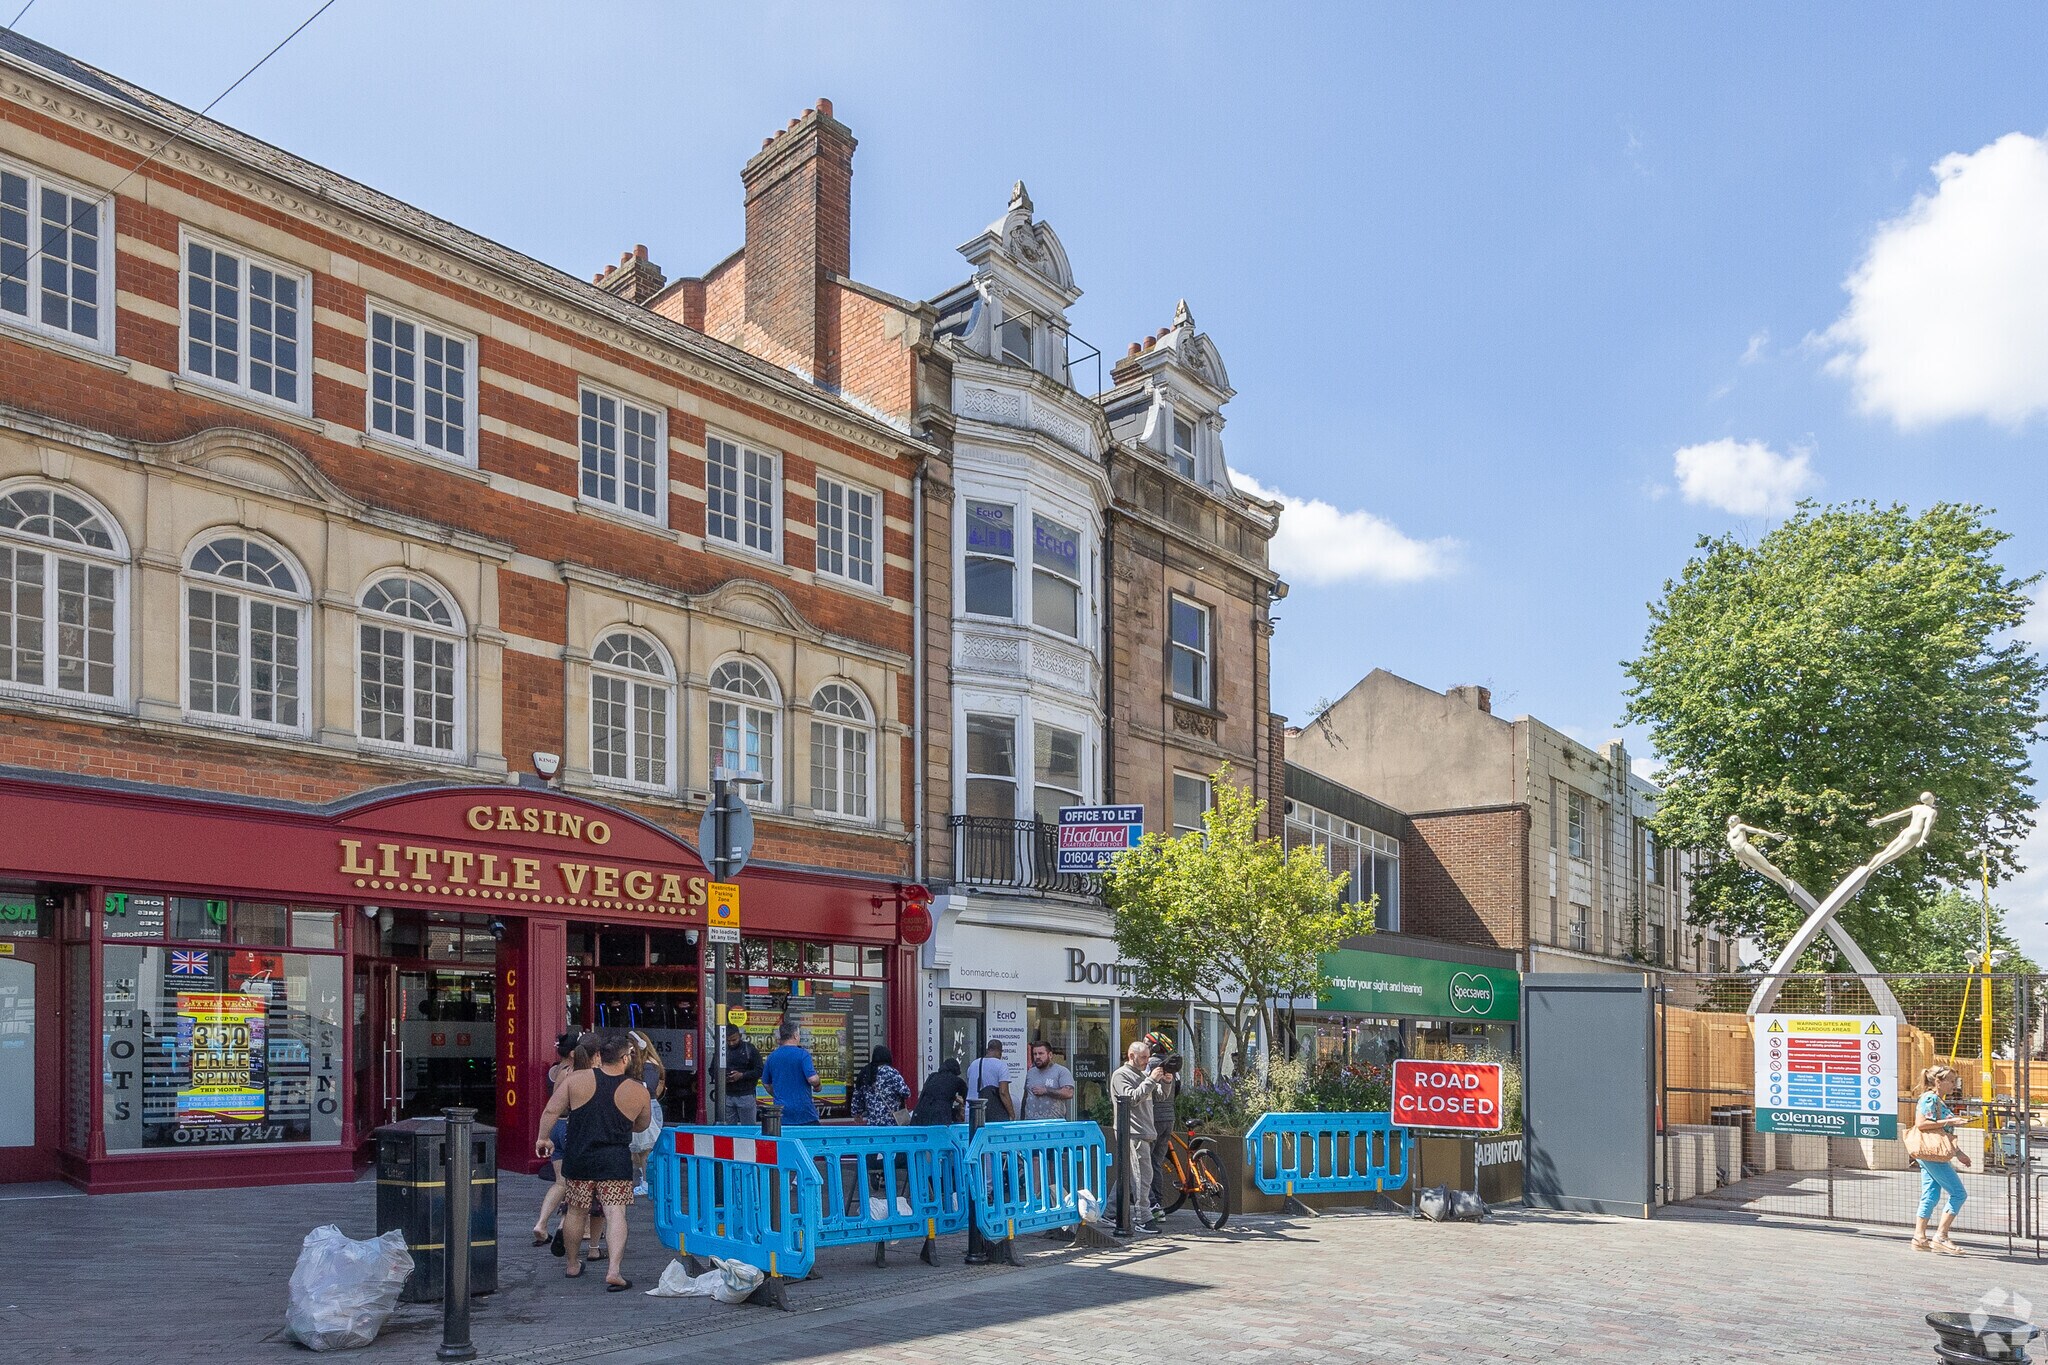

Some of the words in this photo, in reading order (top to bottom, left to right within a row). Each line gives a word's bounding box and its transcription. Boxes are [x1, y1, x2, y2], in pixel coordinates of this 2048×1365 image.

[1065, 811, 1099, 822] OFFICE
[1102, 811, 1115, 820] TO
[1118, 810, 1136, 820] LET
[466, 805, 611, 845] CASINO
[1063, 827, 1126, 843] Hadland
[1064, 852, 1094, 863] 01604
[339, 839, 541, 891] LITTLE
[559, 863, 707, 906] VEGAS
[960, 966, 1019, 979] bonmarche.co.uk
[1347, 976, 1357, 988] for
[1357, 979, 1372, 991] your
[1373, 980, 1388, 992] sight
[1389, 981, 1400, 992] and
[1401, 982, 1423, 997] hearing
[1454, 984, 1490, 1000] Specsavers
[184, 999, 222, 1007] LITTLE
[226, 999, 258, 1007] VEGAS
[196, 1026, 246, 1045] 350
[506, 969, 516, 1106] CASINO
[195, 1052, 246, 1067] FREE
[196, 1071, 248, 1084] SPINS
[1415, 1072, 1480, 1090] ROAD
[1399, 1094, 1494, 1115] CLOSED
[173, 1128, 236, 1143] OPEN
[241, 1126, 285, 1140] 24/7
